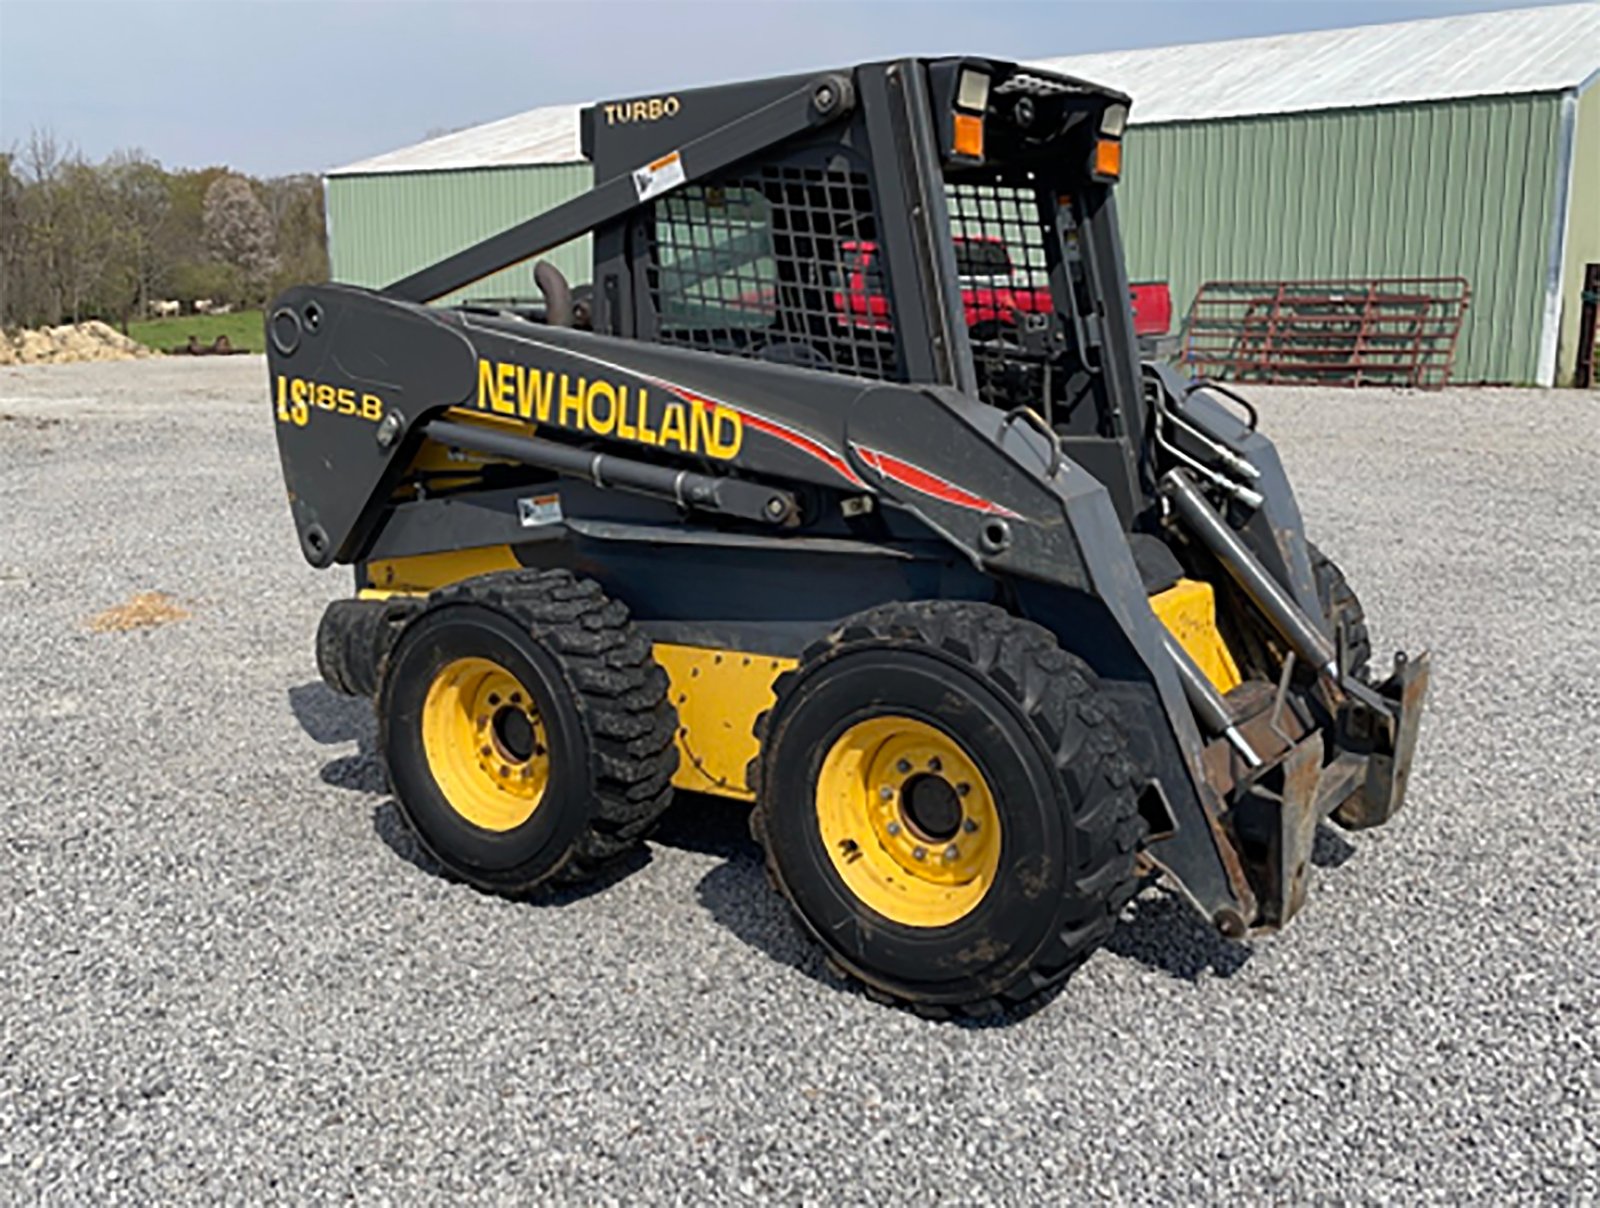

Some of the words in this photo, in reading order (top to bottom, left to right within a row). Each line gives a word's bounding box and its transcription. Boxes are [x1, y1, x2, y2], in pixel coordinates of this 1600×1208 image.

[604, 96, 680, 125] TURBO
[478, 359, 555, 422] NEW
[559, 374, 742, 460] HOLLAND
